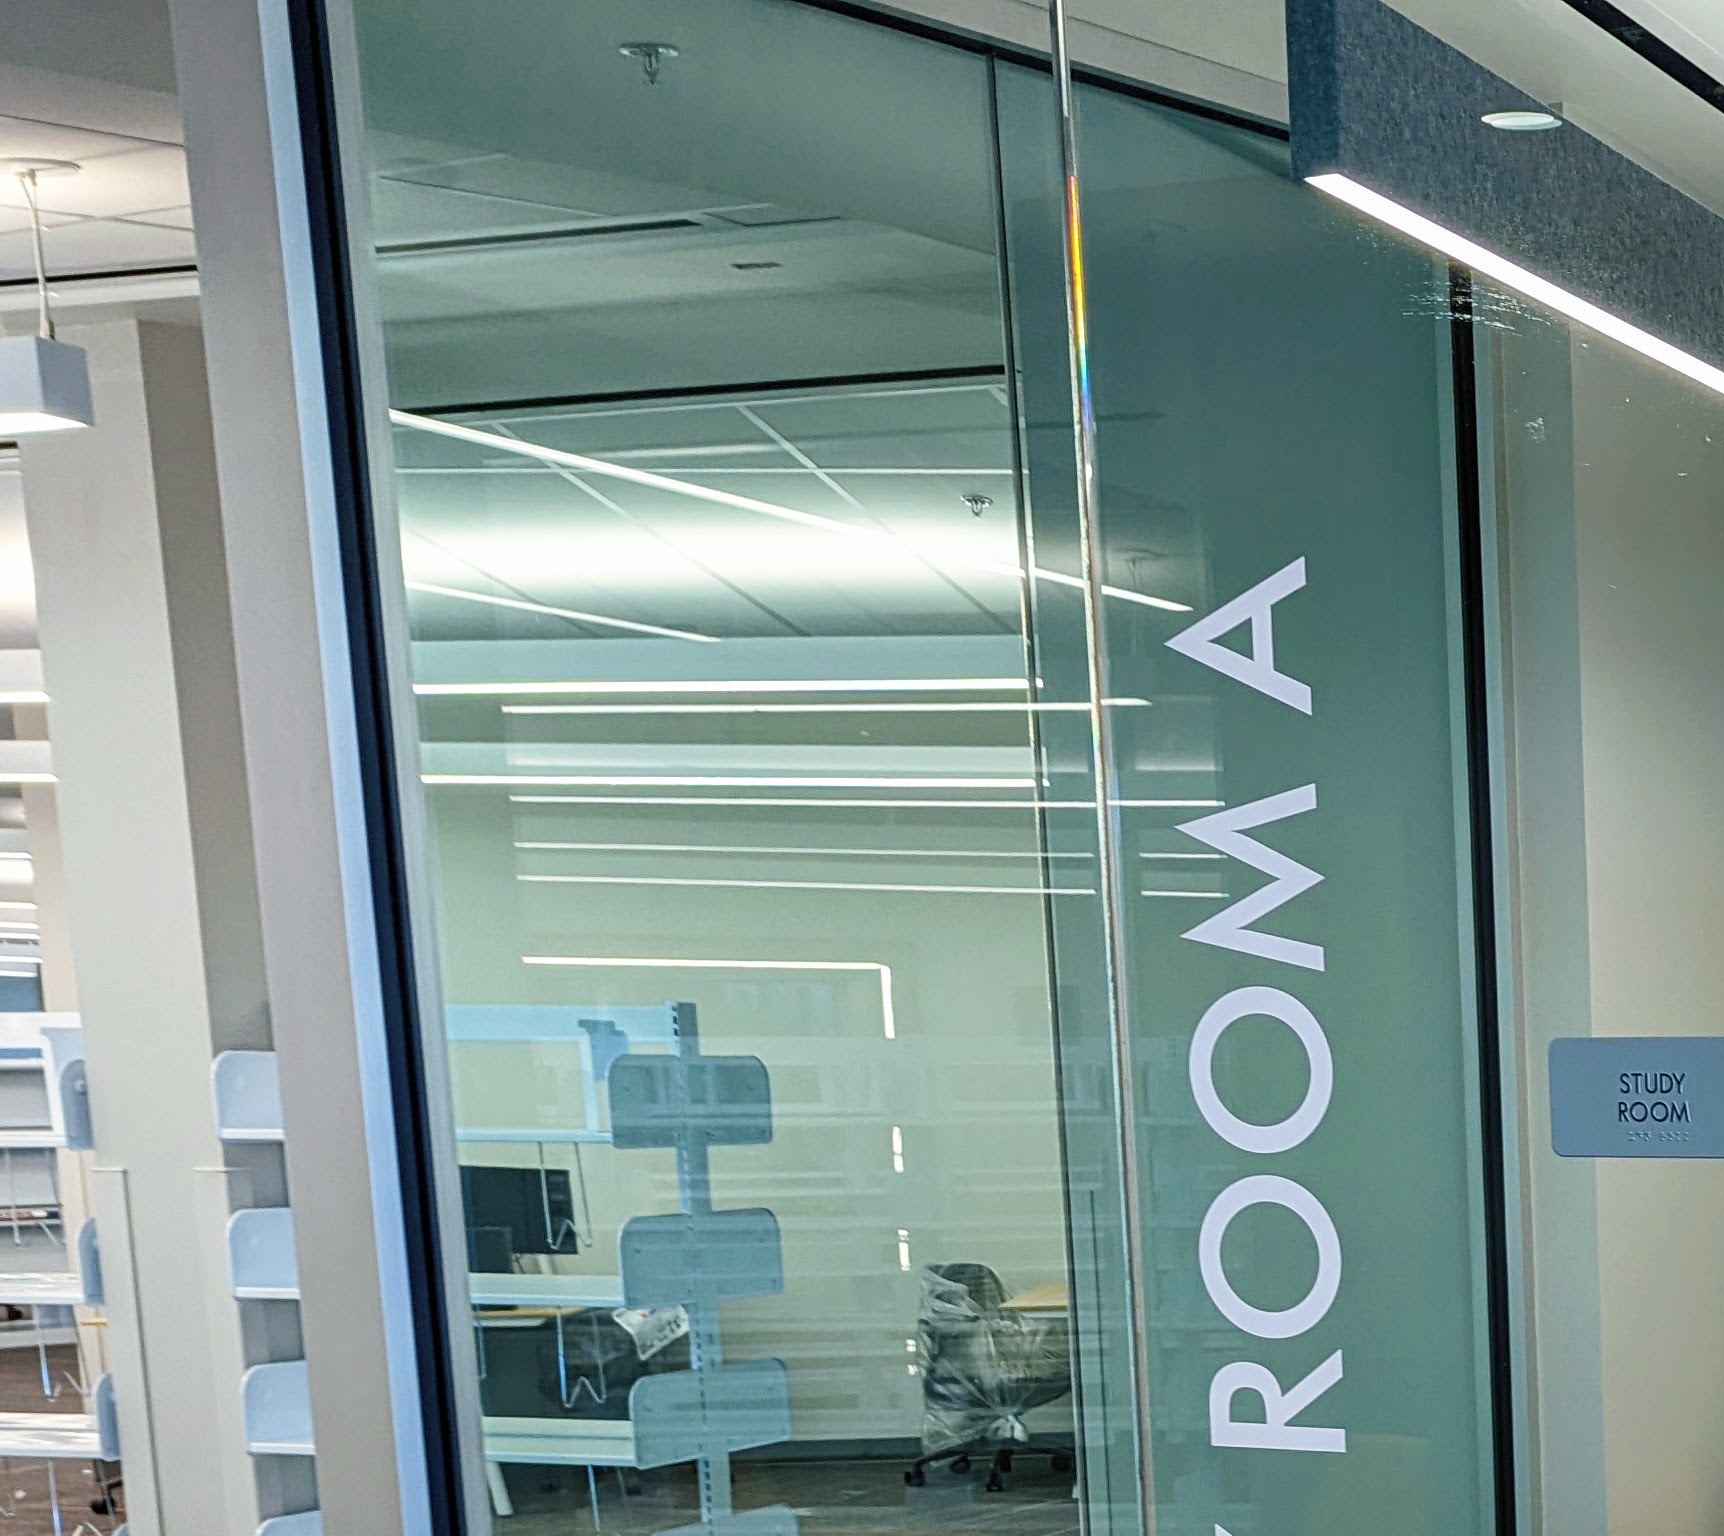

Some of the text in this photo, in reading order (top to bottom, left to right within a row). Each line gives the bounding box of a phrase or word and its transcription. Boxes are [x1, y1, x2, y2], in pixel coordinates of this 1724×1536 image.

[1164, 556, 1313, 716] A
[1174, 783, 1346, 1453] ROOM
[1617, 1101, 1691, 1124] ROOM
[1618, 1072, 1687, 1095] STUDY
